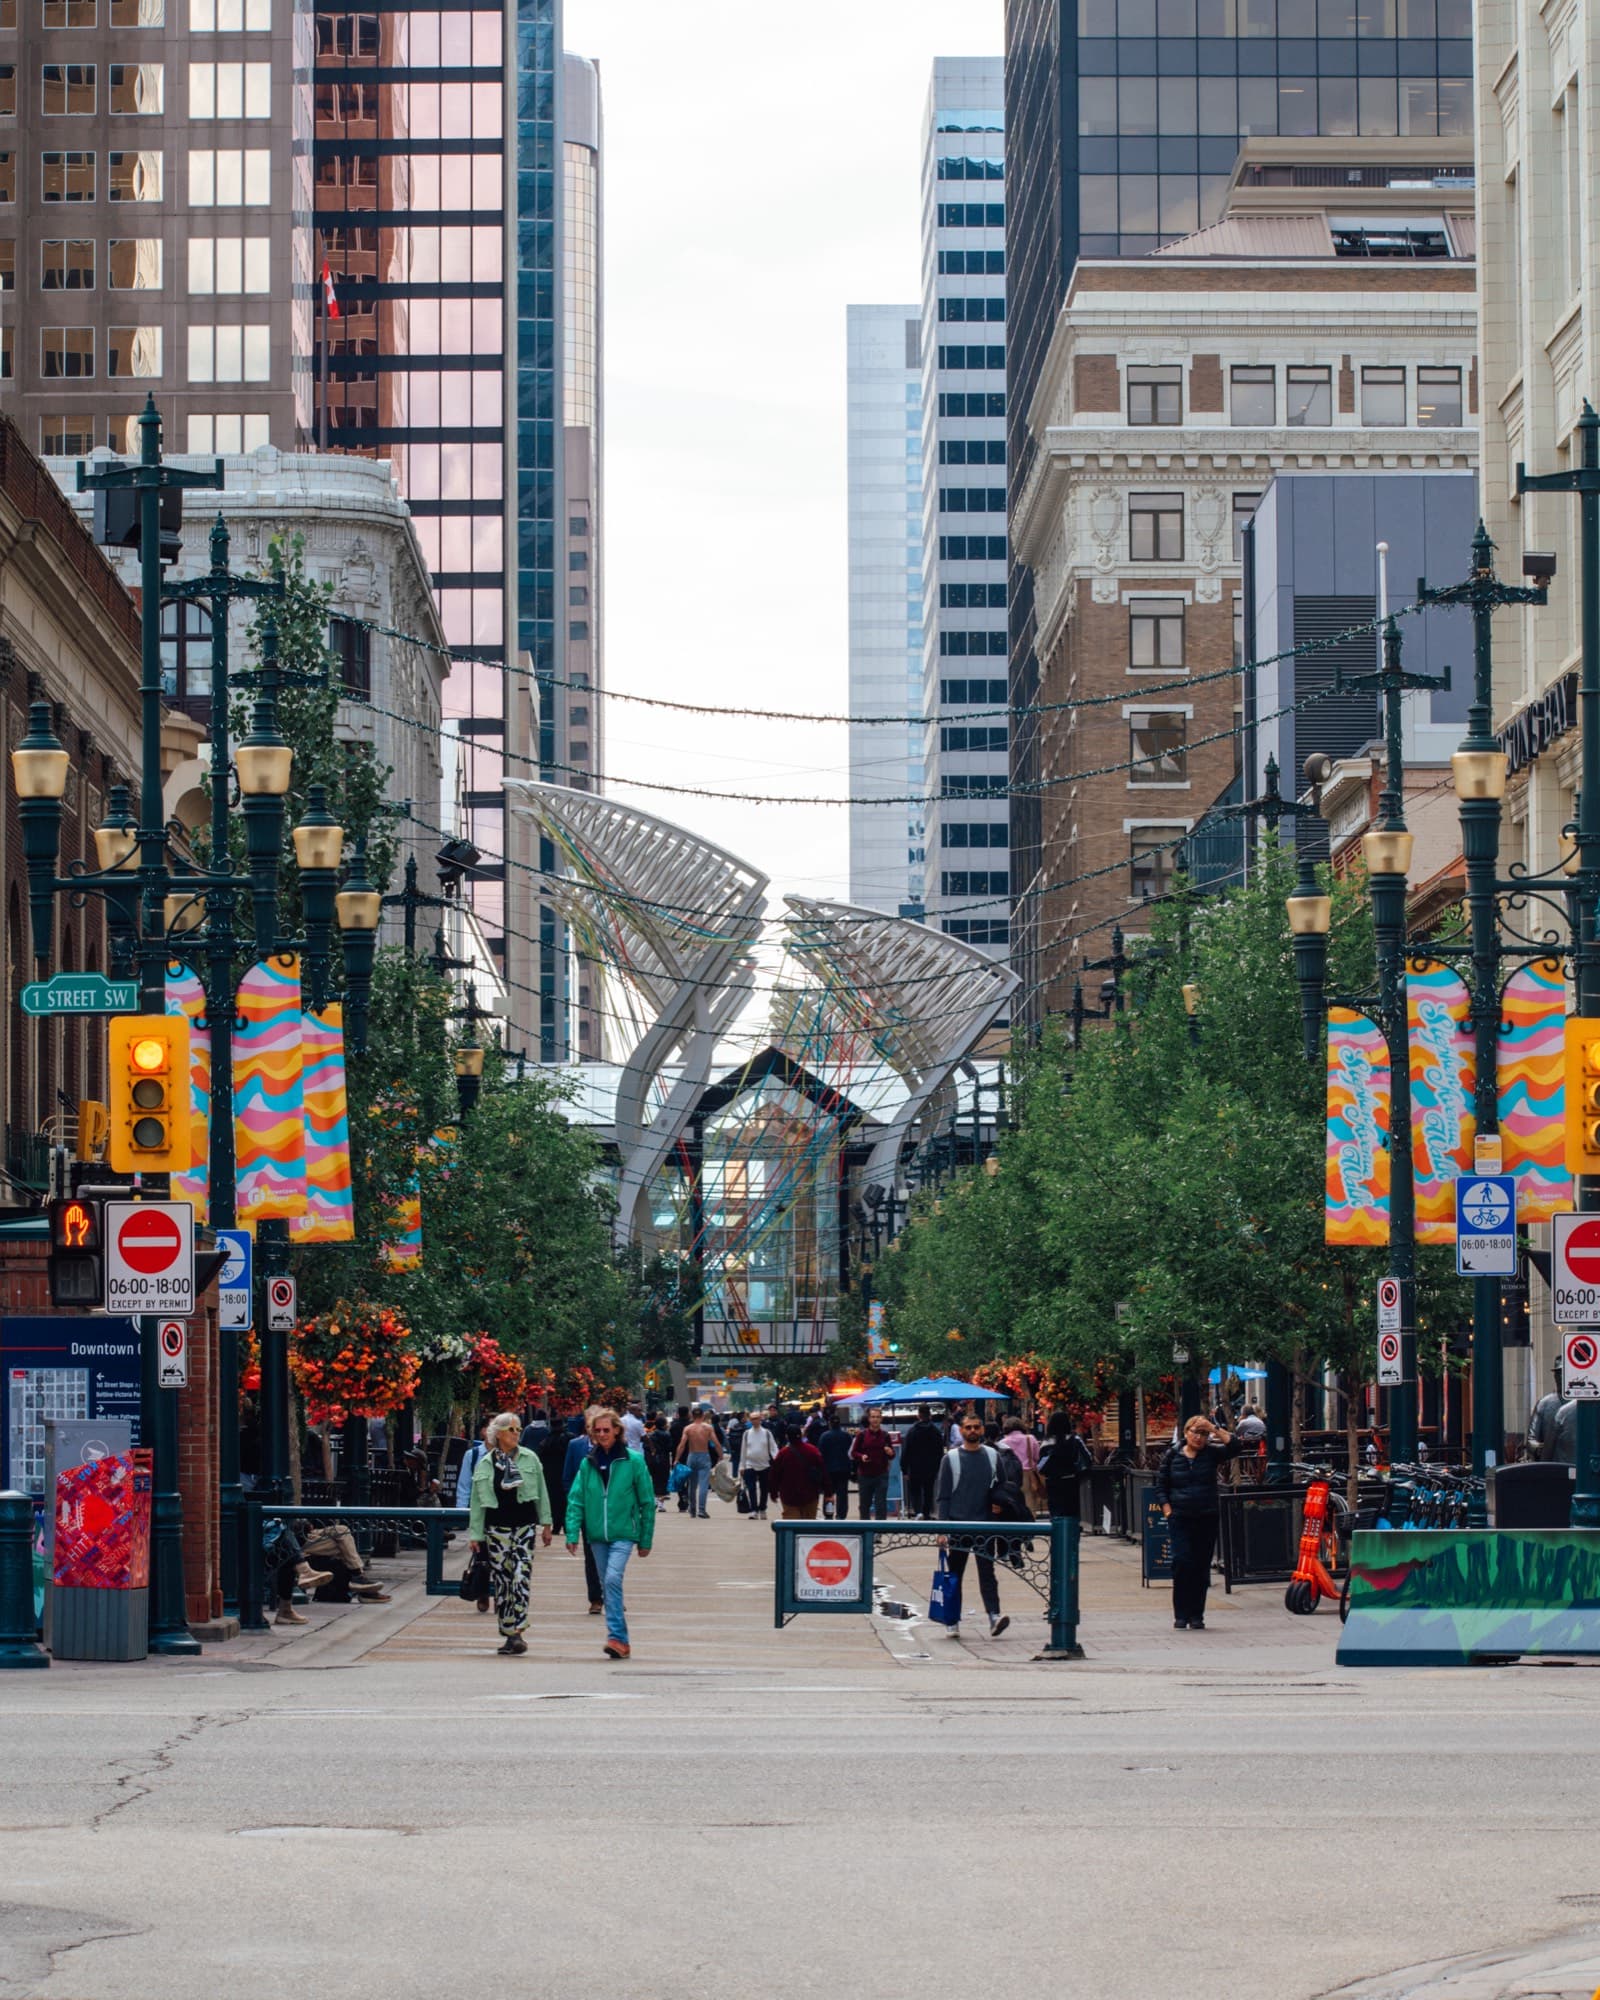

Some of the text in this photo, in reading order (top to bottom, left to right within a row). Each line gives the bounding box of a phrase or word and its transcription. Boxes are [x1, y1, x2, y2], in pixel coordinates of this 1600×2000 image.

[1543, 672, 1572, 744] BAY
[33, 989, 129, 1007] 1 STREET SW
[1419, 1001, 1466, 1147] Stephen Avenue
[1340, 1047, 1379, 1178] Stephen Avenue
[1424, 1112, 1460, 1181] Walk
[1340, 1146, 1373, 1207] Walk
[1461, 1238, 1512, 1250] 06:00-18:00
[109, 1278, 191, 1295] 06:00-18:00
[112, 1299, 188, 1309] EXCEPT BY PERMIT
[1558, 1309, 1589, 1320] EXCEPT
[71, 1342, 134, 1356] Downtown
[800, 1588, 857, 1597] EXCEPT BICYCLES
